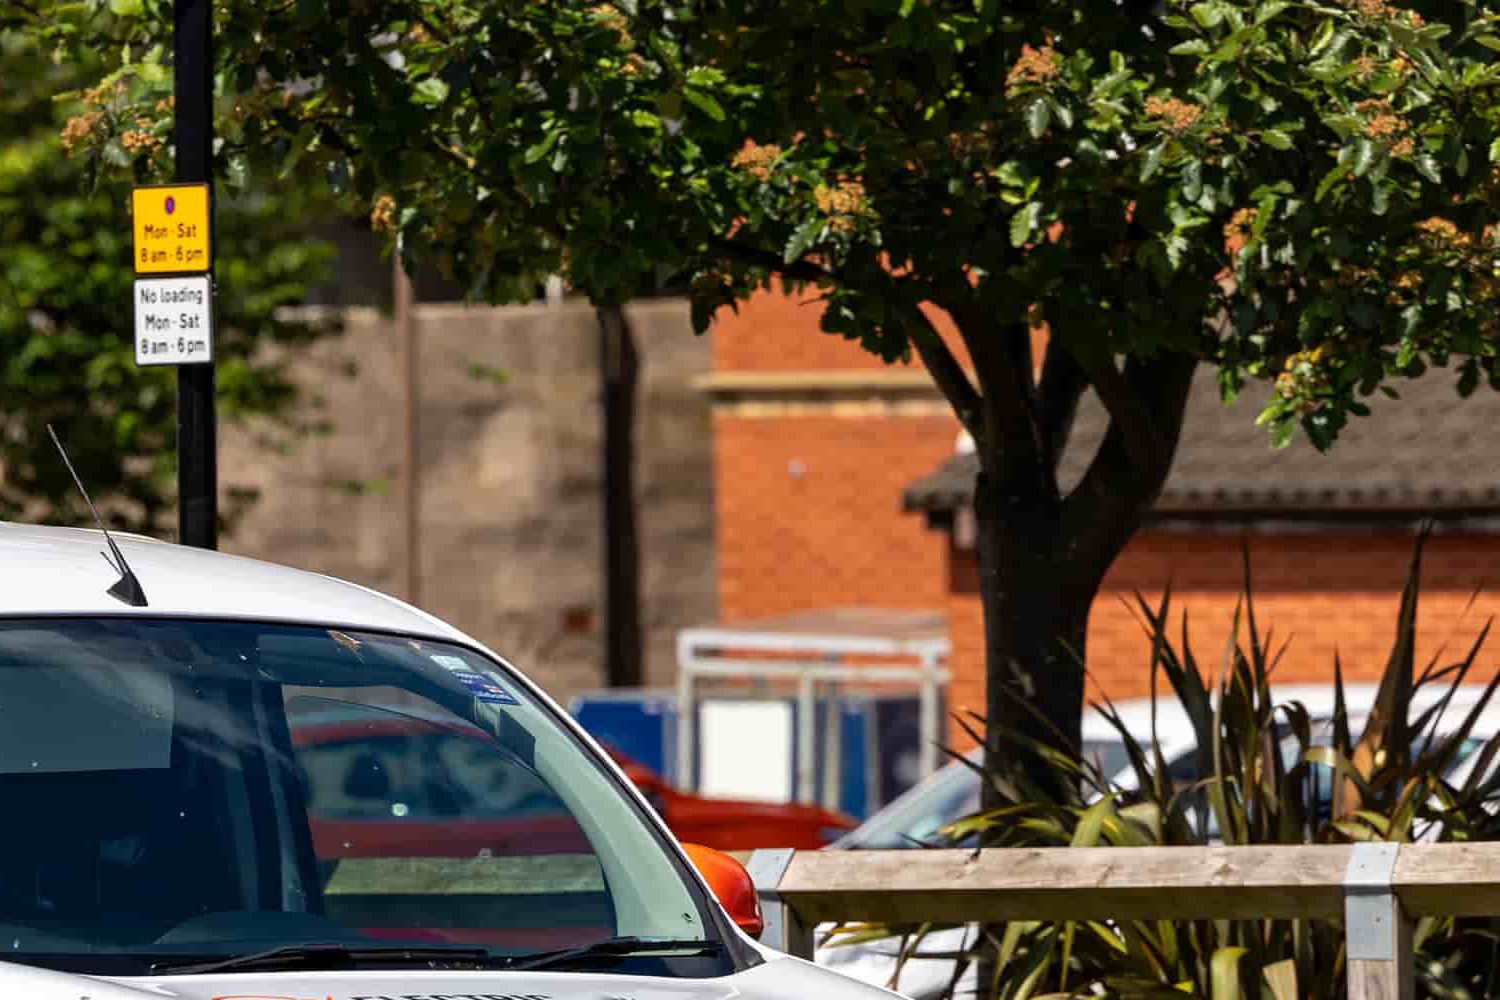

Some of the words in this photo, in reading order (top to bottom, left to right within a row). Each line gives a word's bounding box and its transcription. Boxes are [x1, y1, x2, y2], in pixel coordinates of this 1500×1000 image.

[143, 223, 168, 239] Mon
[177, 222, 197, 239] Sat
[140, 287, 158, 304] No
[160, 287, 203, 305] loading
[144, 314, 171, 330] Mon
[179, 313, 200, 329] Sat
